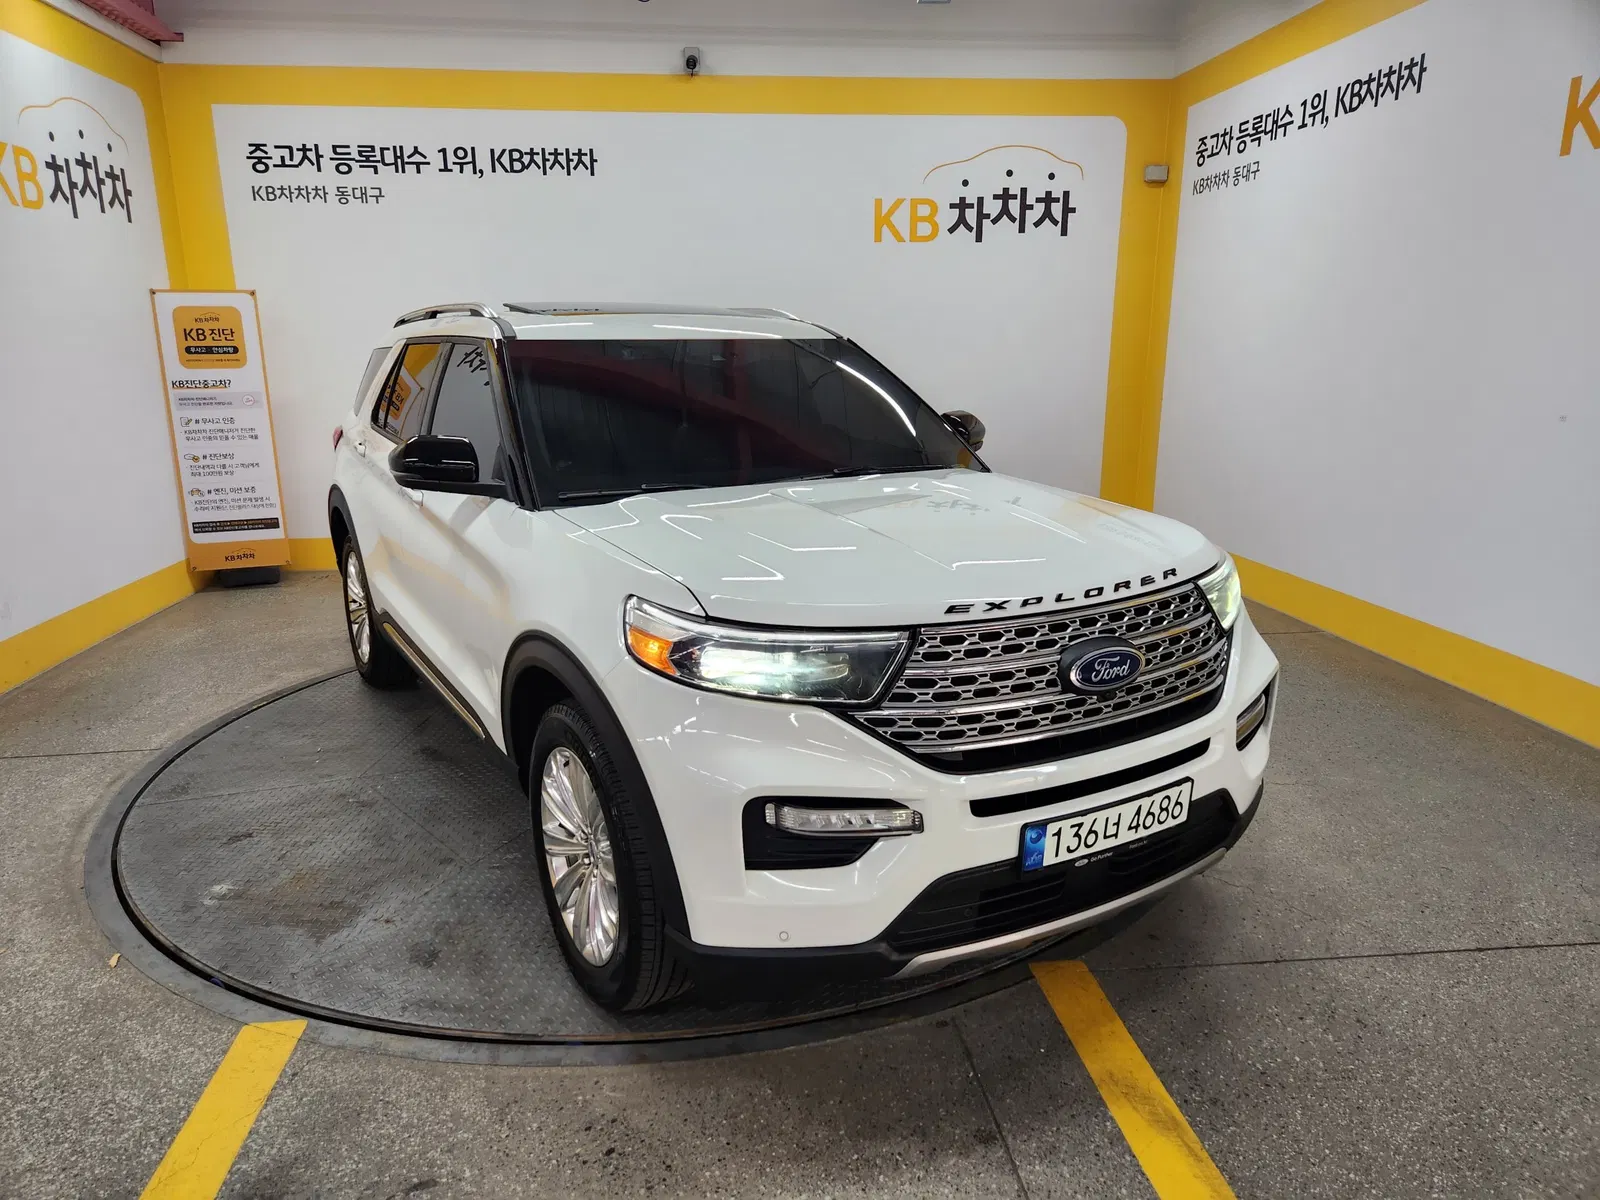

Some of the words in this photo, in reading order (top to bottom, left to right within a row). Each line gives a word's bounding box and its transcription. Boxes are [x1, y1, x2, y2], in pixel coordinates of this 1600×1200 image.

[1195, 125, 1234, 168] 중고차
[1236, 104, 1294, 154] 등록대수
[1297, 89, 1329, 128] 1위,
[1335, 53, 1427, 117] KB차차차
[45, 129, 133, 223] 차차차
[246, 143, 324, 174] 중고차
[329, 144, 431, 175] 등록대수
[437, 146, 484, 179] 1위,
[489, 147, 598, 176] KB차차차
[1192, 169, 1230, 196] KB차차차
[1232, 161, 1261, 187] 동대구
[251, 185, 329, 203] KB차차차
[335, 186, 385, 205] 동대구
[874, 197, 940, 243] KB
[947, 168, 1077, 243] 차차차
[183, 328, 207, 342] KB
[209, 328, 235, 342] 진단
[171, 379, 232, 389] KB진단중고차?
[222, 417, 236, 425] 인증
[236, 551, 255, 561] 차차차
[943, 567, 1178, 614] EXPLORER
[1091, 655, 1131, 683] Ford
[1052, 813, 1122, 857] 136너
[1127, 790, 1183, 833] 4686
